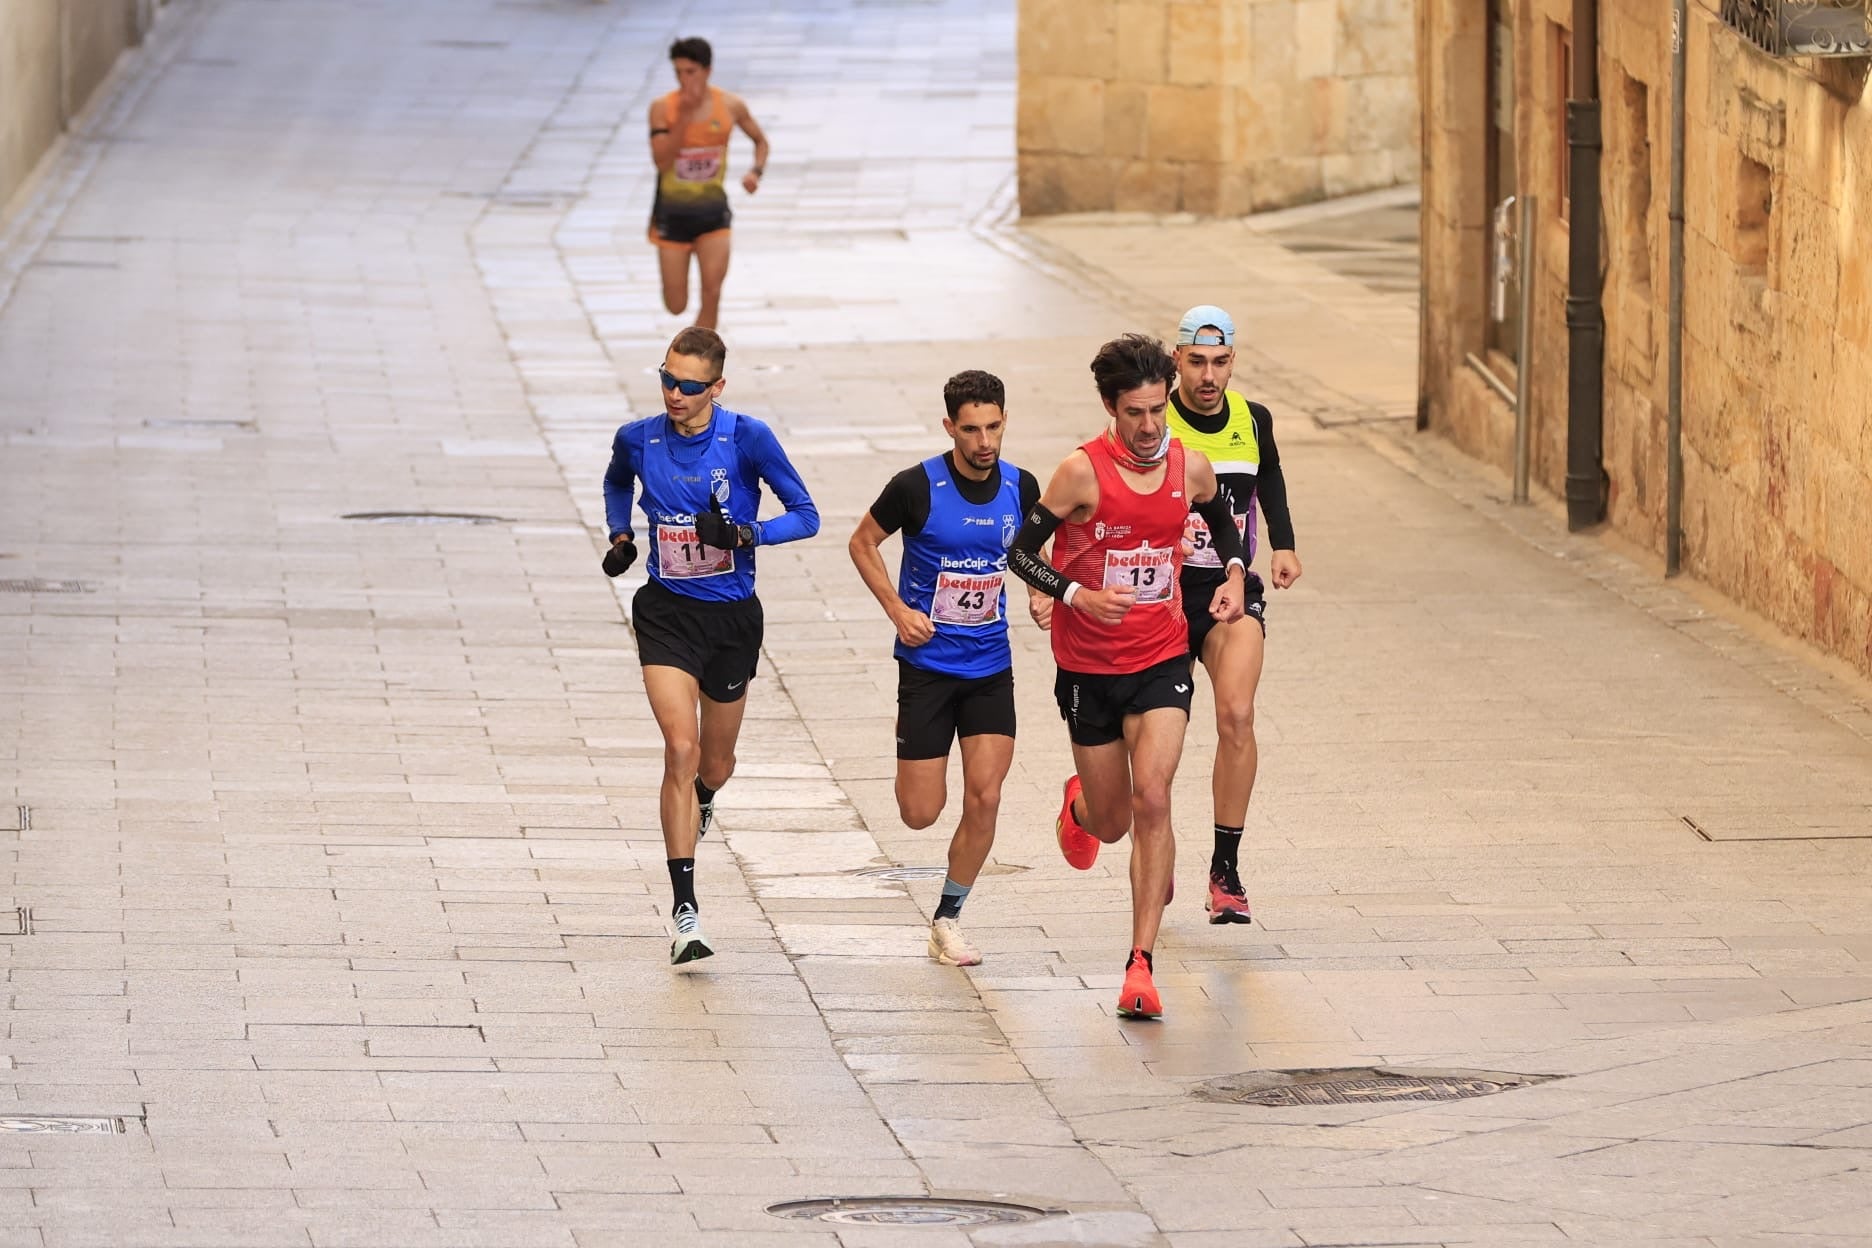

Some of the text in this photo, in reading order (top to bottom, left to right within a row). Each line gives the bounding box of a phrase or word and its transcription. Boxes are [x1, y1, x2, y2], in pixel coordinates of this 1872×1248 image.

[656, 511, 698, 525] berCaj
[659, 527, 700, 543] bedu
[681, 543, 706, 562] 11
[941, 556, 988, 571] iberCaja
[939, 574, 1003, 591] bedunia
[1130, 567, 1156, 587] 13
[957, 592, 985, 610] 43
